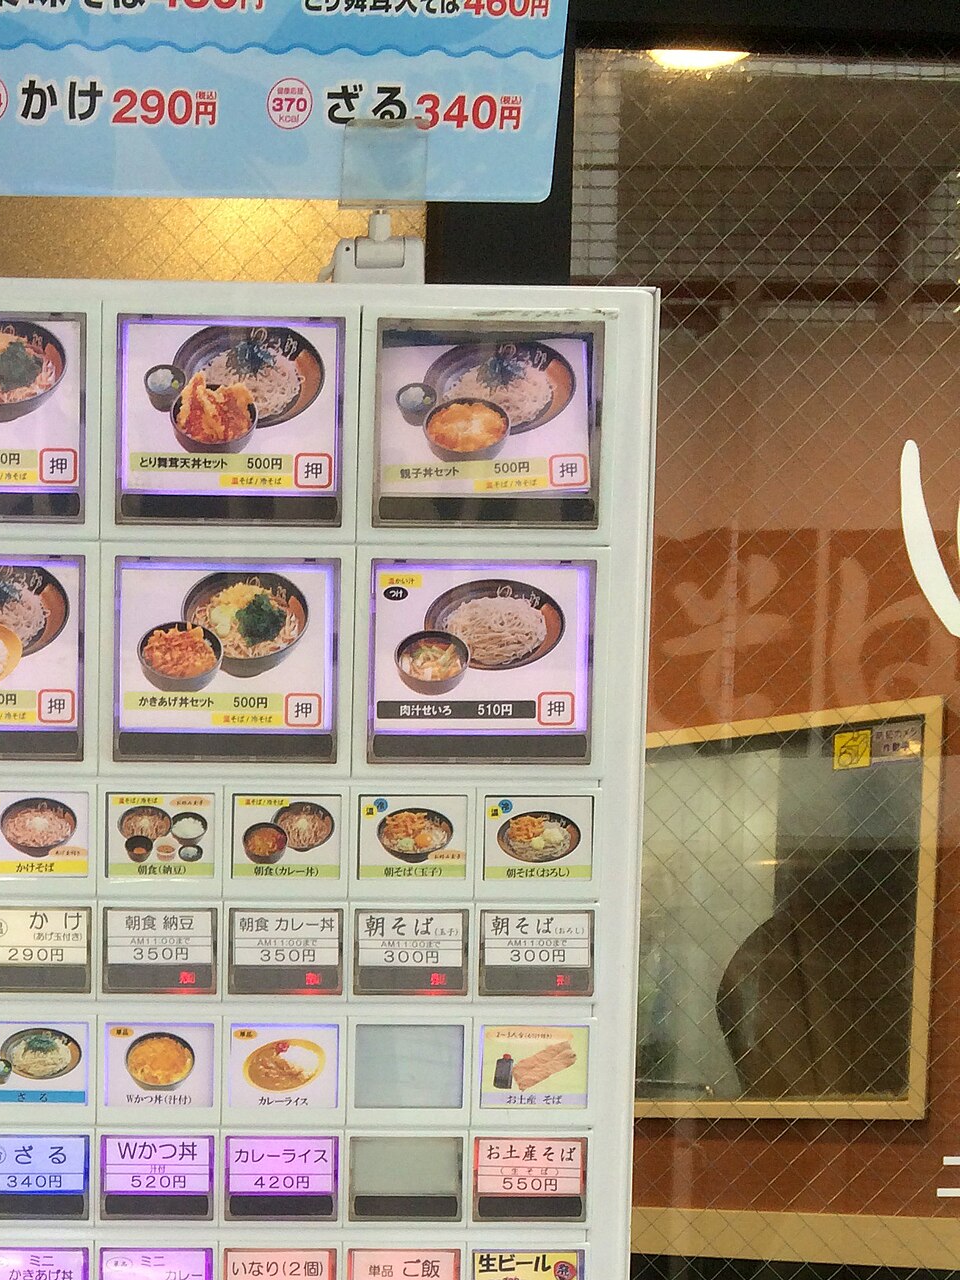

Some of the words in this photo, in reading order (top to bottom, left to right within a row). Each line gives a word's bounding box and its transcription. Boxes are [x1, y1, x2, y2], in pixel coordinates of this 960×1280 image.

[21, 80, 103, 121] かけ
[112, 89, 216, 126] 290円
[272, 98, 307, 113] 370
[326, 85, 407, 123] ざる
[415, 93, 521, 130] 340円
[140, 457, 228, 470] とり舞茸天丼セット
[247, 457, 282, 470] 500円
[400, 467, 459, 479] 親子丼セット
[494, 462, 529, 474] 500円
[560, 462, 577, 477] 押
[48, 698, 66, 714] 押
[139, 696, 214, 708] かきあげ丼セット
[233, 697, 268, 709] 500円
[548, 700, 565, 716] 押
[400, 705, 452, 716] 肉汁せいろ
[478, 704, 512, 716] 510円
[16, 862, 54, 872] かけそば
[125, 916, 156, 930] 朝食
[163, 916, 194, 930] 納豆
[240, 917, 268, 931] 朝食
[276, 917, 335, 932] カレー丼
[8, 948, 64, 962] 290円
[133, 948, 189, 961] 350円
[260, 949, 315, 962] 350円
[384, 950, 439, 963] 300円
[510, 950, 565, 962] 300円
[259, 1097, 308, 1106] カレーライス
[118, 1142, 197, 1160] Wかつ丼
[235, 1149, 328, 1163] カレーライス
[487, 1145, 575, 1162] お土産そば
[7, 1176, 62, 1188] 340円
[131, 1175, 186, 1188] 520円
[254, 1176, 309, 1188] 420円
[502, 1178, 557, 1191] 550円
[403, 1260, 440, 1278] ご飯
[478, 1254, 551, 1273] 生ビール
